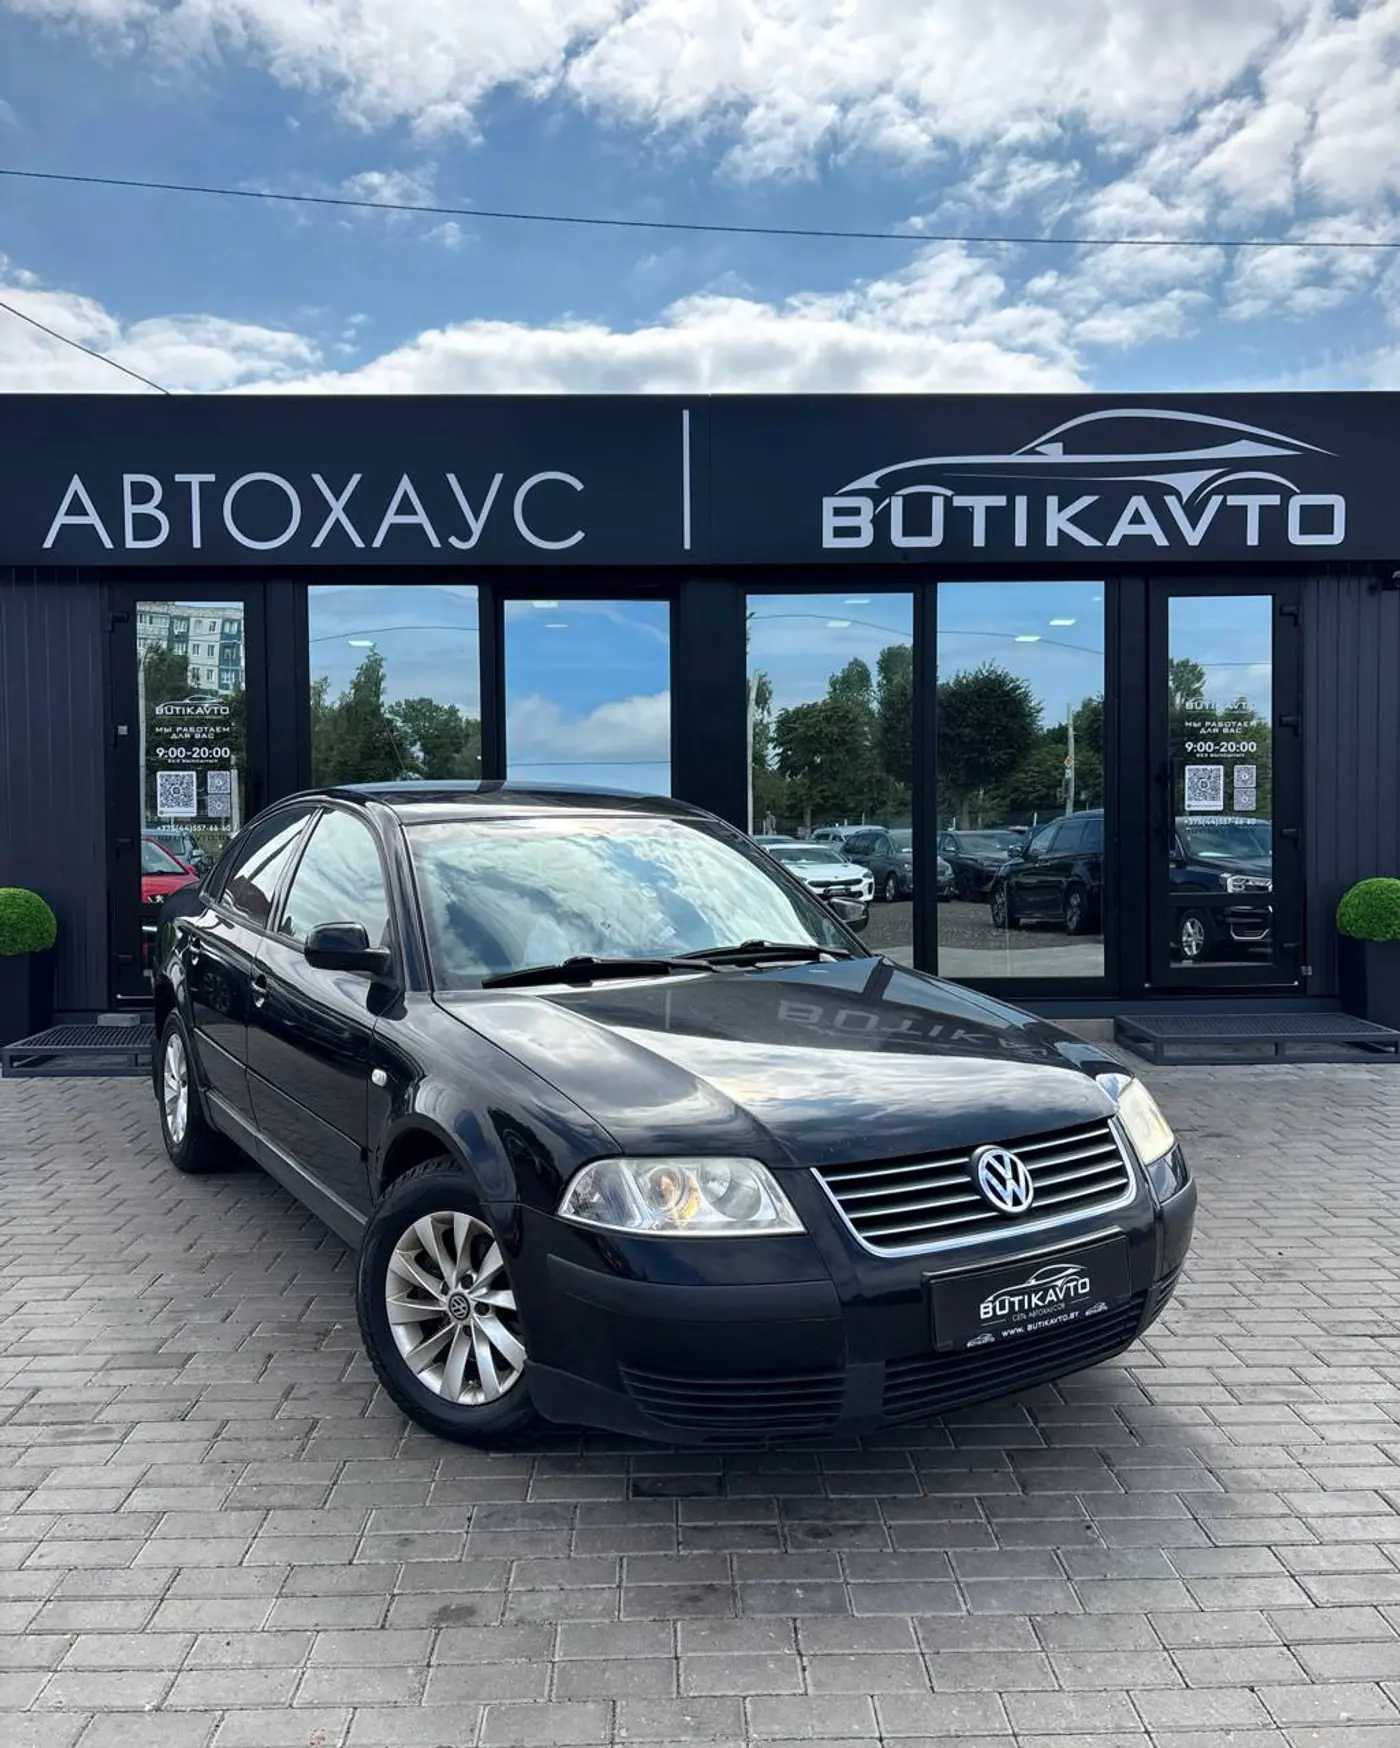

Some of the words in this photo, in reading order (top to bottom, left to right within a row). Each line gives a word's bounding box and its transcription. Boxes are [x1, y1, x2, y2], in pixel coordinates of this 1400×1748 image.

[42, 470, 586, 551] АВТОХАУС
[821, 493, 1347, 549] BUTIKAVTO
[155, 706, 230, 716] BUTIKAVTO
[1185, 701, 1257, 710] BUTIAVT
[1199, 727, 1219, 735] ДЛЯ
[156, 747, 230, 758] 9:00-20:00
[1185, 742, 1257, 753] 9:00-20:00
[980, 1278, 1090, 1319] BUTIKAVTO
